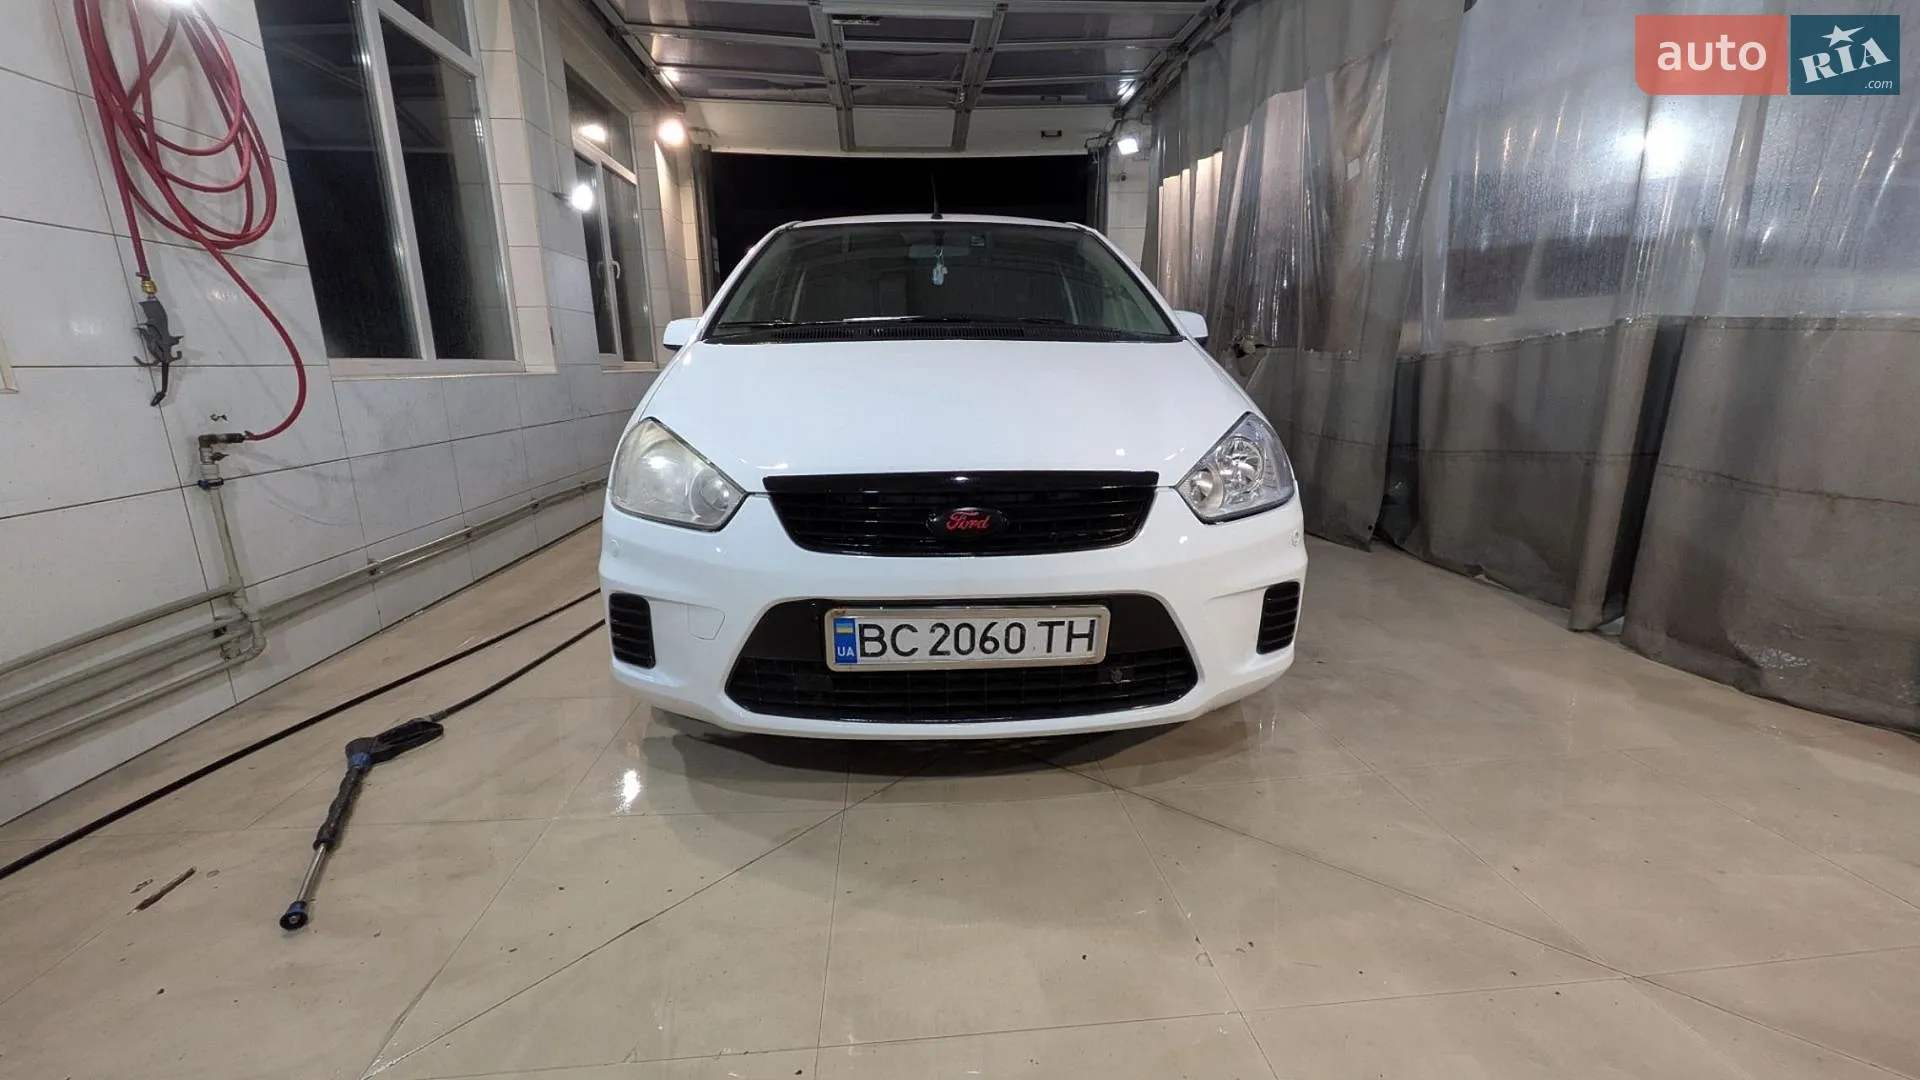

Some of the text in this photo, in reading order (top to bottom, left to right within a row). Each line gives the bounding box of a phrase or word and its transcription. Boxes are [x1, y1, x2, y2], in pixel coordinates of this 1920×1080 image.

[946, 511, 991, 530] Ford
[858, 619, 1097, 658] BC 2060 TH
[837, 646, 855, 658] UA
